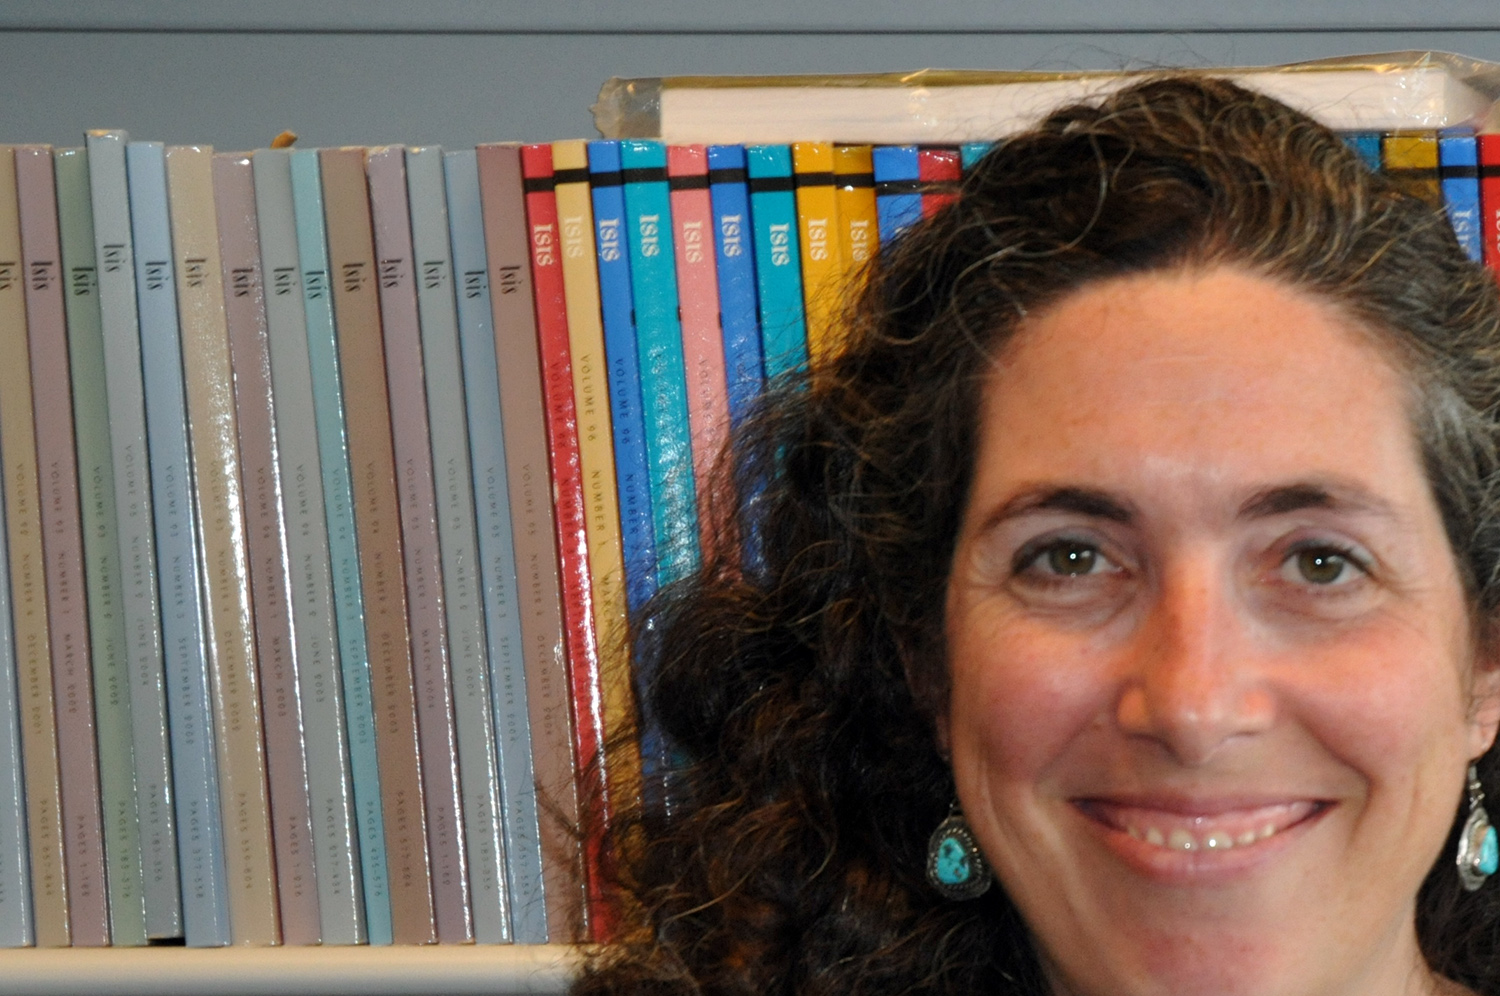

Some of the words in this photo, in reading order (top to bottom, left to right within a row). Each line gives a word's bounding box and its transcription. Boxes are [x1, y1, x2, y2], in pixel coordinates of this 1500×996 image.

[534, 224, 552, 266] ISIS
[564, 216, 583, 259] ISIS
[599, 218, 620, 263] ISIS
[639, 214, 660, 258] ISIS
[683, 221, 702, 264] ISIS
[722, 215, 742, 258] ISIS
[769, 223, 790, 266] ISIS
[808, 218, 828, 262] ISIS
[851, 220, 869, 262] ISIS
[31, 261, 54, 291] Isis
[103, 244, 127, 273] Isis
[145, 261, 170, 291] Isis
[342, 263, 366, 292] Isis
[232, 268, 255, 298] Isis
[305, 271, 327, 300] Isis
[464, 271, 487, 299] Isis
[579, 354, 595, 416] VOLUME
[586, 425, 596, 442] 96
[591, 470, 605, 532] NUMBER
[332, 468, 344, 518] VOLUME
[342, 558, 353, 609] NUMBER
[351, 640, 363, 708] SEPTEMBER
[366, 801, 377, 840] PAGES
